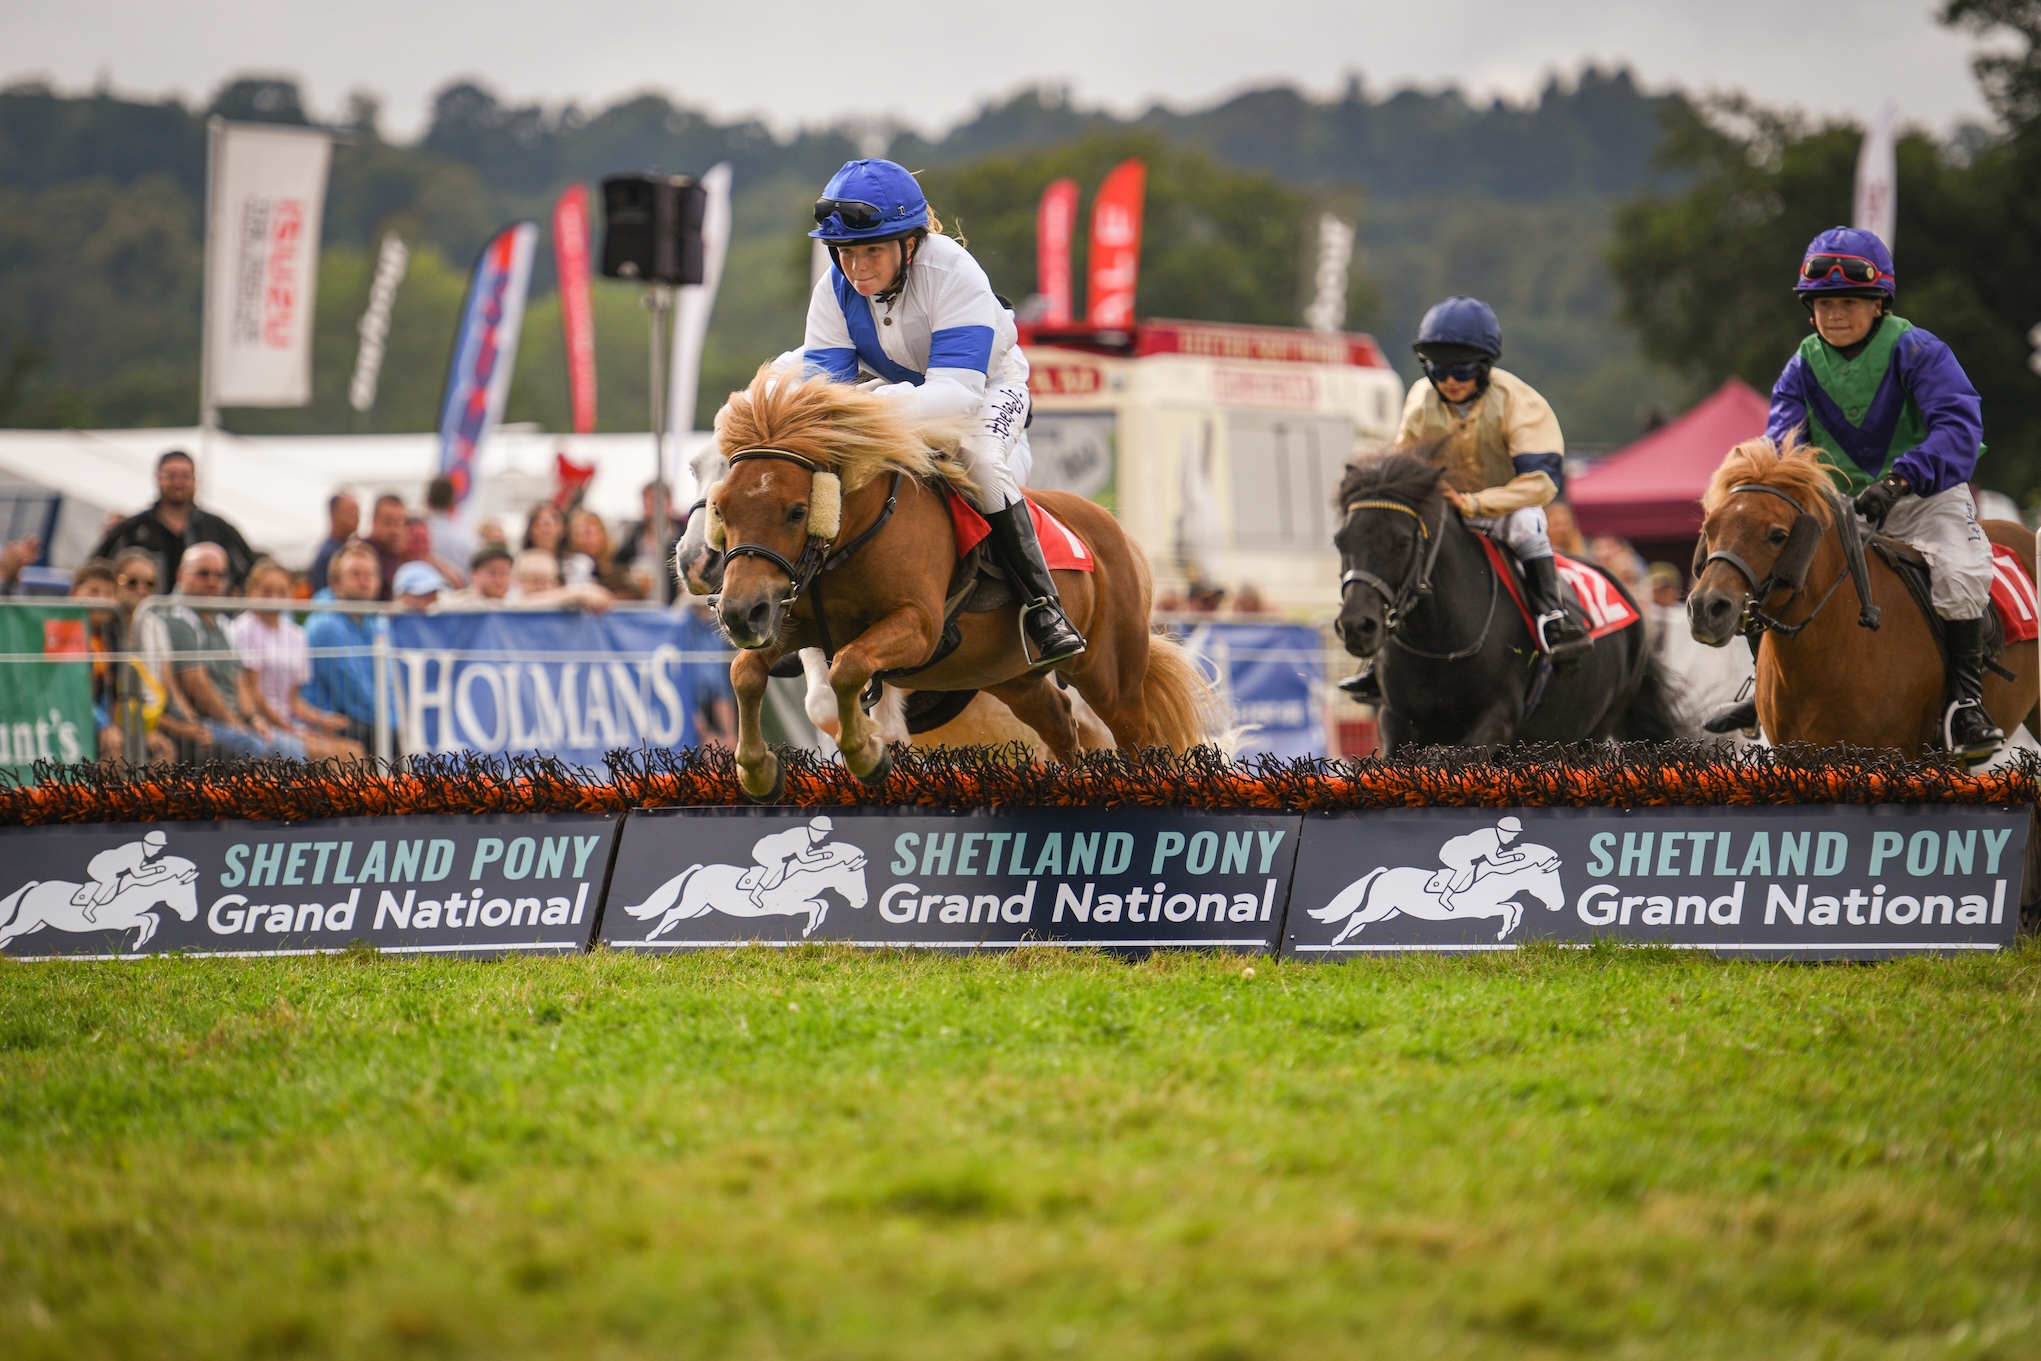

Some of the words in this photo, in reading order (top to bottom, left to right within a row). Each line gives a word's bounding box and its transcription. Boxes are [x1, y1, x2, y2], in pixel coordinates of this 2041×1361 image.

[1558, 562, 1630, 629] 12
[400, 643, 685, 754] HOLMANS
[221, 838, 457, 888] SHETLAND
[471, 835, 603, 881] PONY
[890, 831, 1136, 876] SHETLAND
[1150, 829, 1286, 875] PONY
[1585, 831, 1848, 877] SHETLAND
[1868, 828, 2012, 876] PONY
[207, 888, 362, 935] Grand
[373, 882, 591, 930] National
[878, 879, 1037, 923] Grand
[1053, 878, 1277, 922] National
[1575, 880, 1746, 926] Grand
[1763, 879, 2006, 925] National
